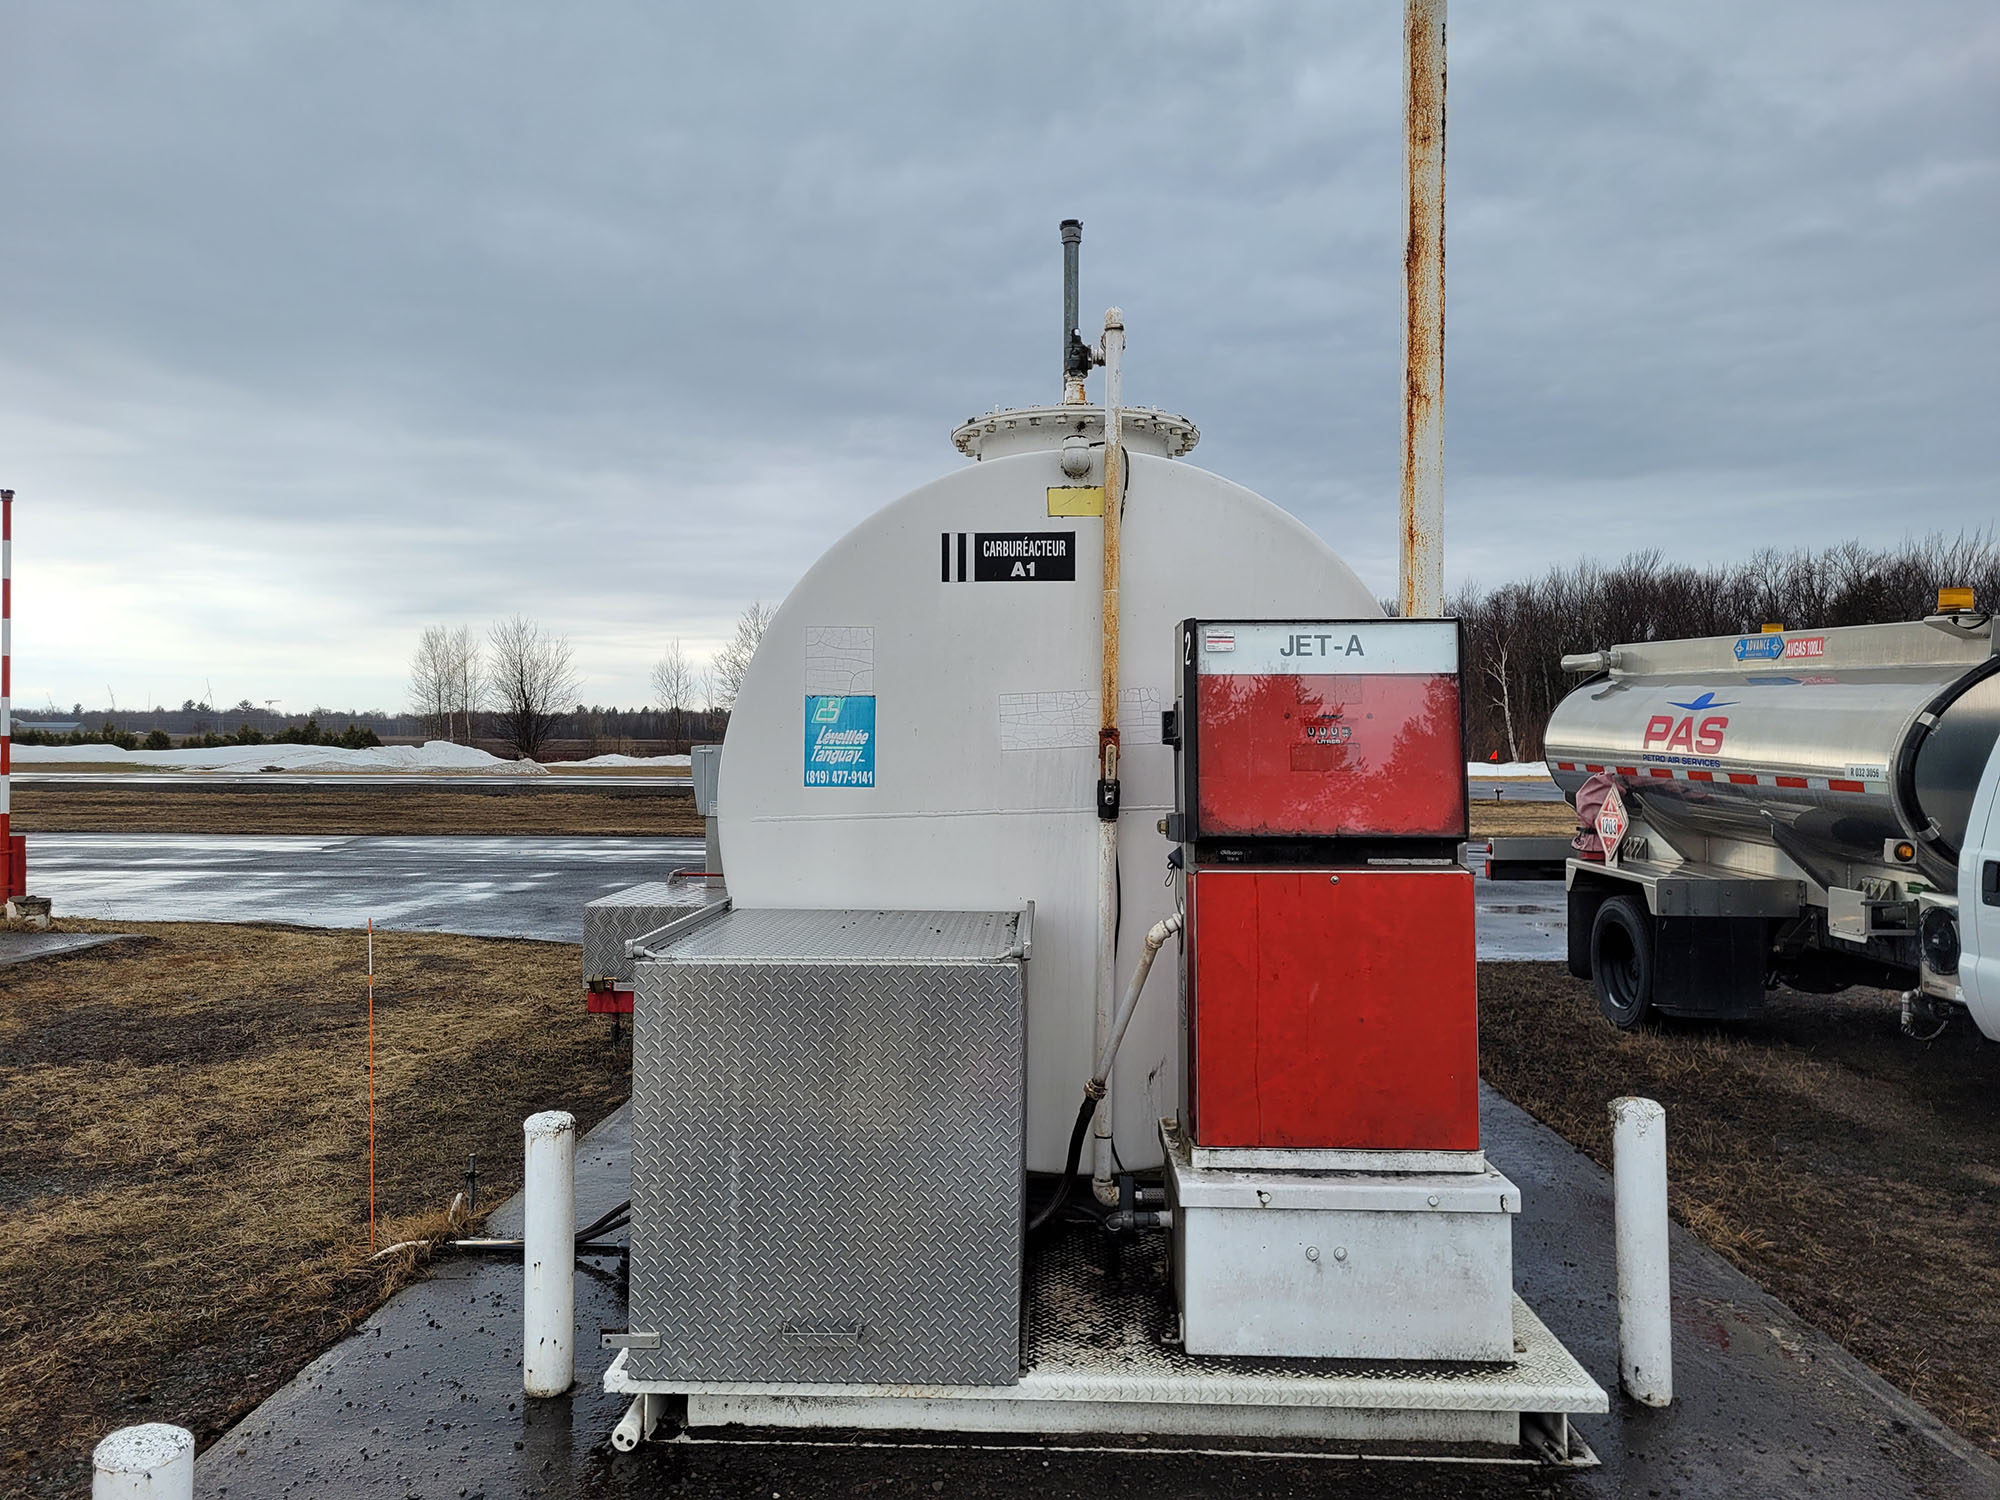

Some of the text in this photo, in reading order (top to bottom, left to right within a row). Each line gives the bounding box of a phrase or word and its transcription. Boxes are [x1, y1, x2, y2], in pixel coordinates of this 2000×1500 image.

[983, 536, 1066, 557] CARBURÉACTEUR
[1010, 561, 1036, 577] A1
[1185, 631, 1191, 665] 2
[1280, 634, 1365, 657] JET-A
[1745, 639, 1770, 651] ADVANCE
[1786, 640, 1823, 656] AVGAS 100LL
[816, 725, 869, 745] Léveillée
[1643, 715, 1729, 754] PAS
[810, 745, 863, 765] Tanguay
[1642, 754, 1666, 763] PETRO
[1681, 757, 1721, 768] SERVICES
[806, 770, 873, 784] (819) 477-9141
[1850, 767, 1855, 777] R
[1602, 818, 1617, 834] 1203
